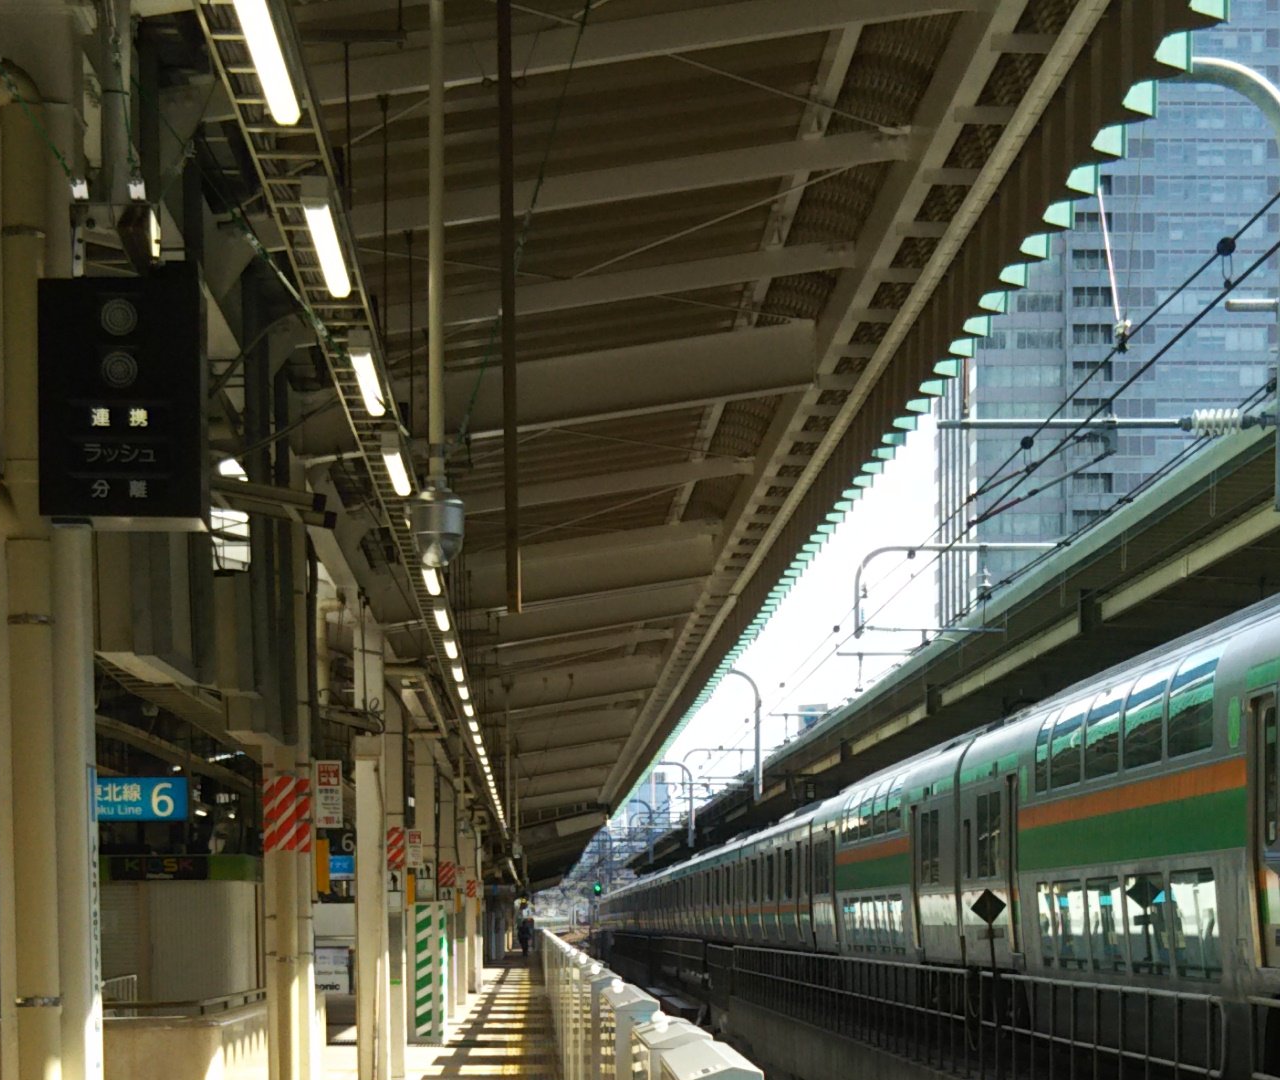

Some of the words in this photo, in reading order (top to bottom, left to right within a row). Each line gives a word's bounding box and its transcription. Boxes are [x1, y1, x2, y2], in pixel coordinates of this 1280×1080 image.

[83, 443, 157, 463] ラッシュ
[91, 479, 149, 499] 分離
[117, 804, 142, 816] Line
[151, 782, 175, 818] 6
[341, 833, 355, 852] 6
